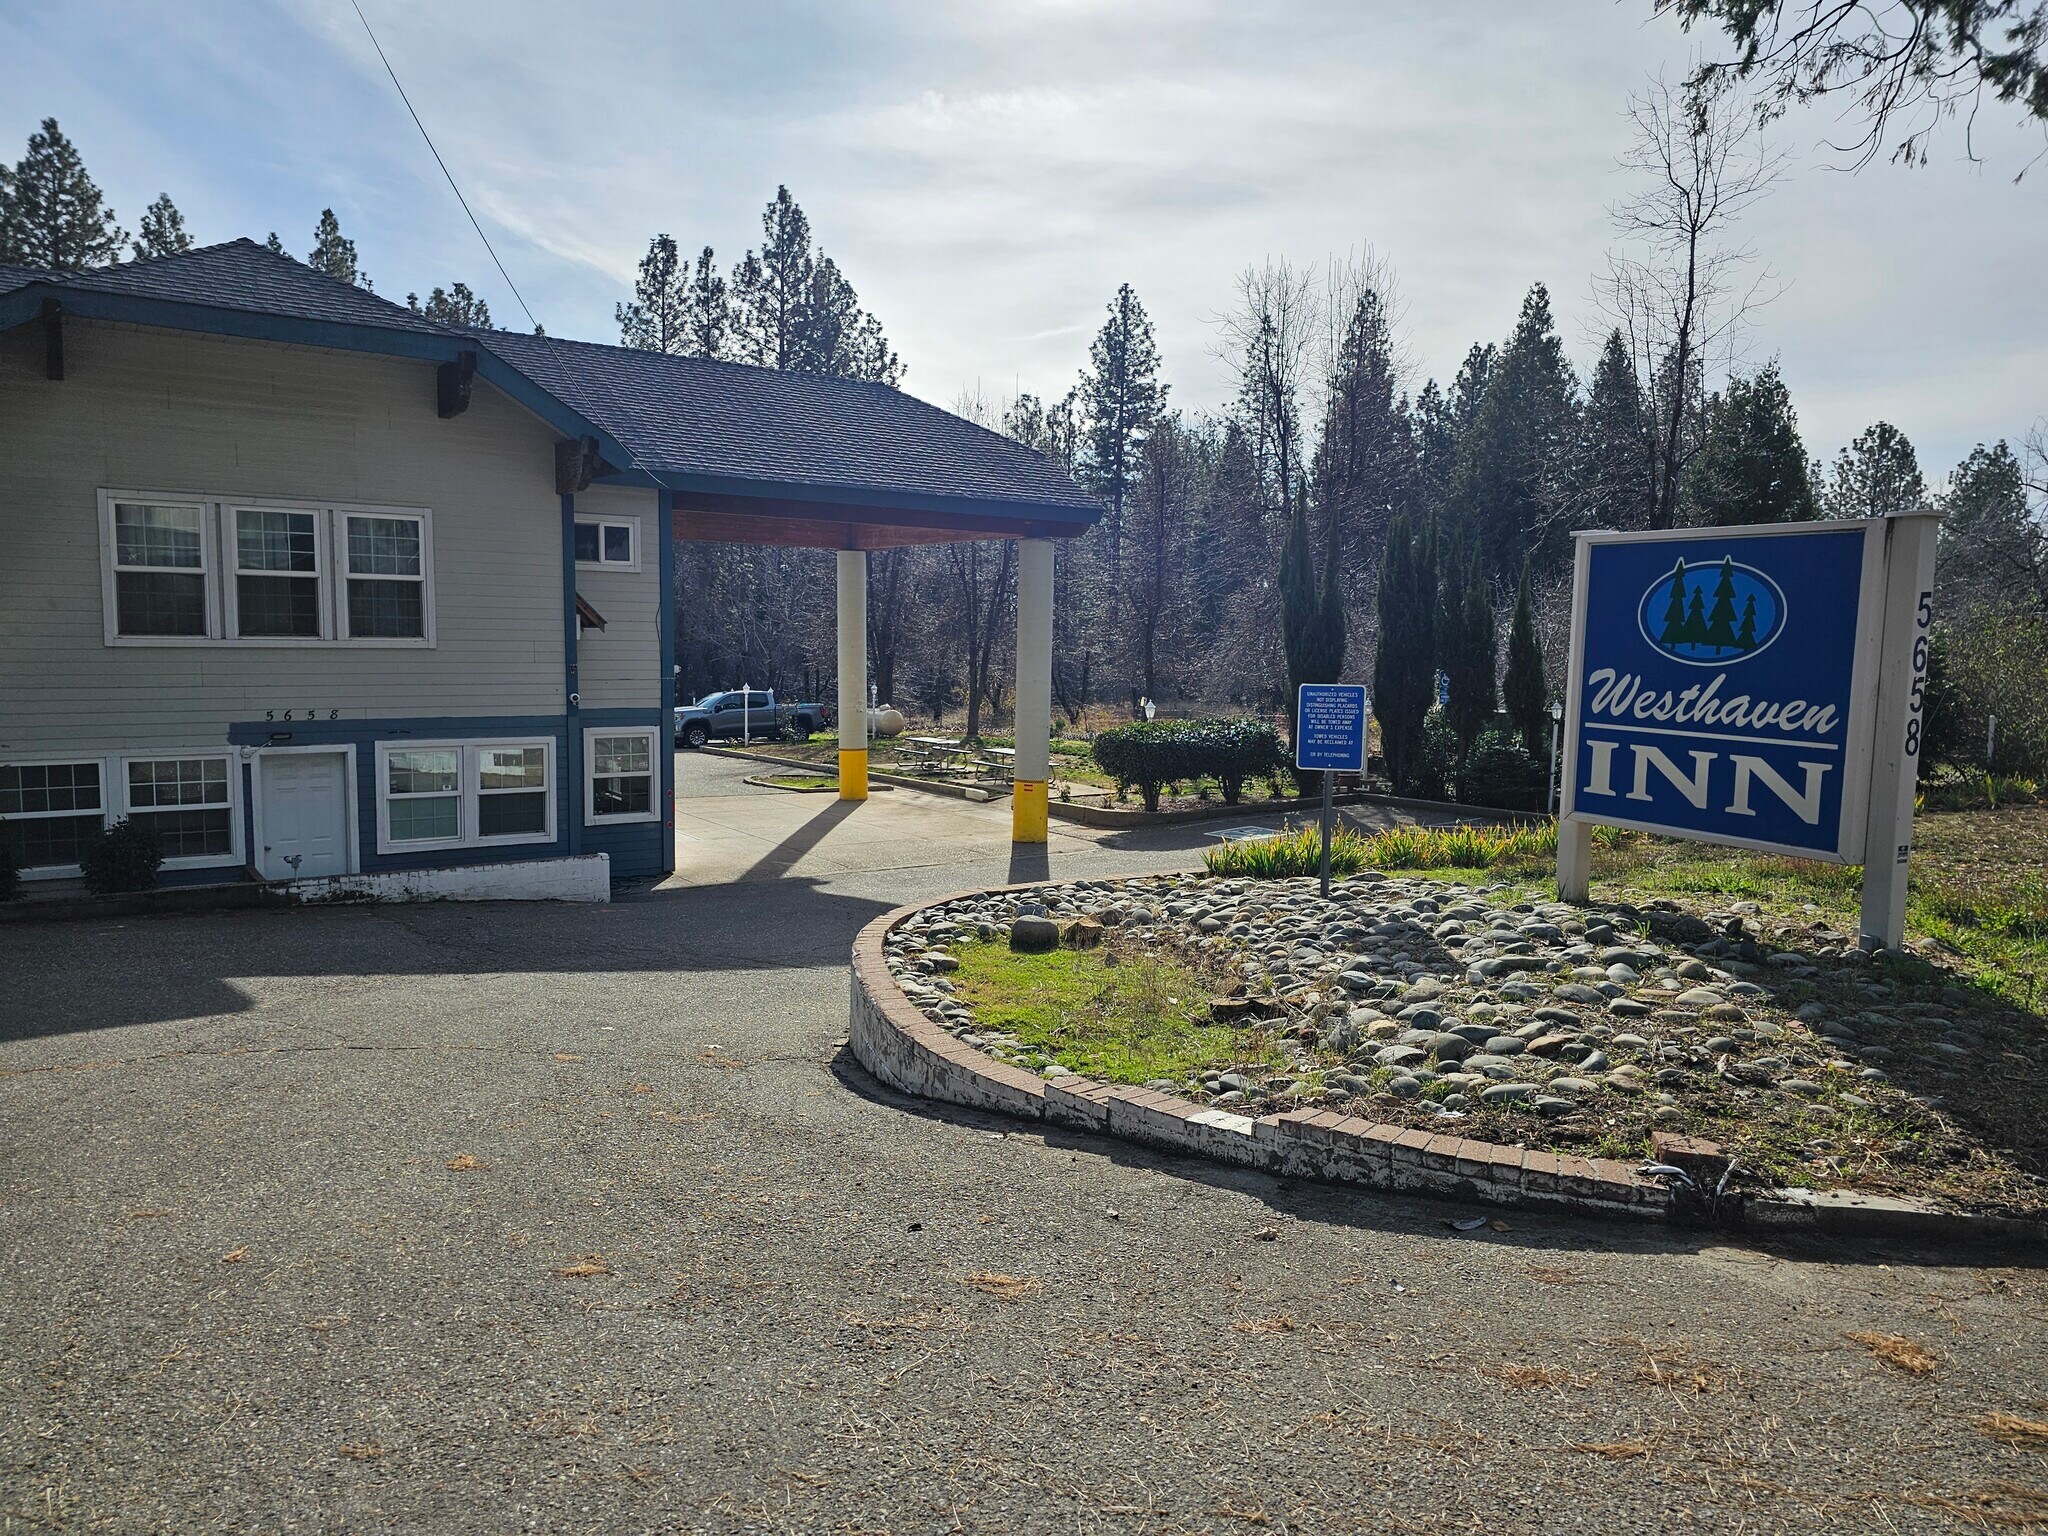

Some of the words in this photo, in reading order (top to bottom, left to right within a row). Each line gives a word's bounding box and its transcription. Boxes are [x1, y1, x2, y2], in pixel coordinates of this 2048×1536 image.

[1588, 667, 1839, 734] Westhaven
[1905, 591, 1932, 757] 5658
[1583, 740, 1833, 825] INN
